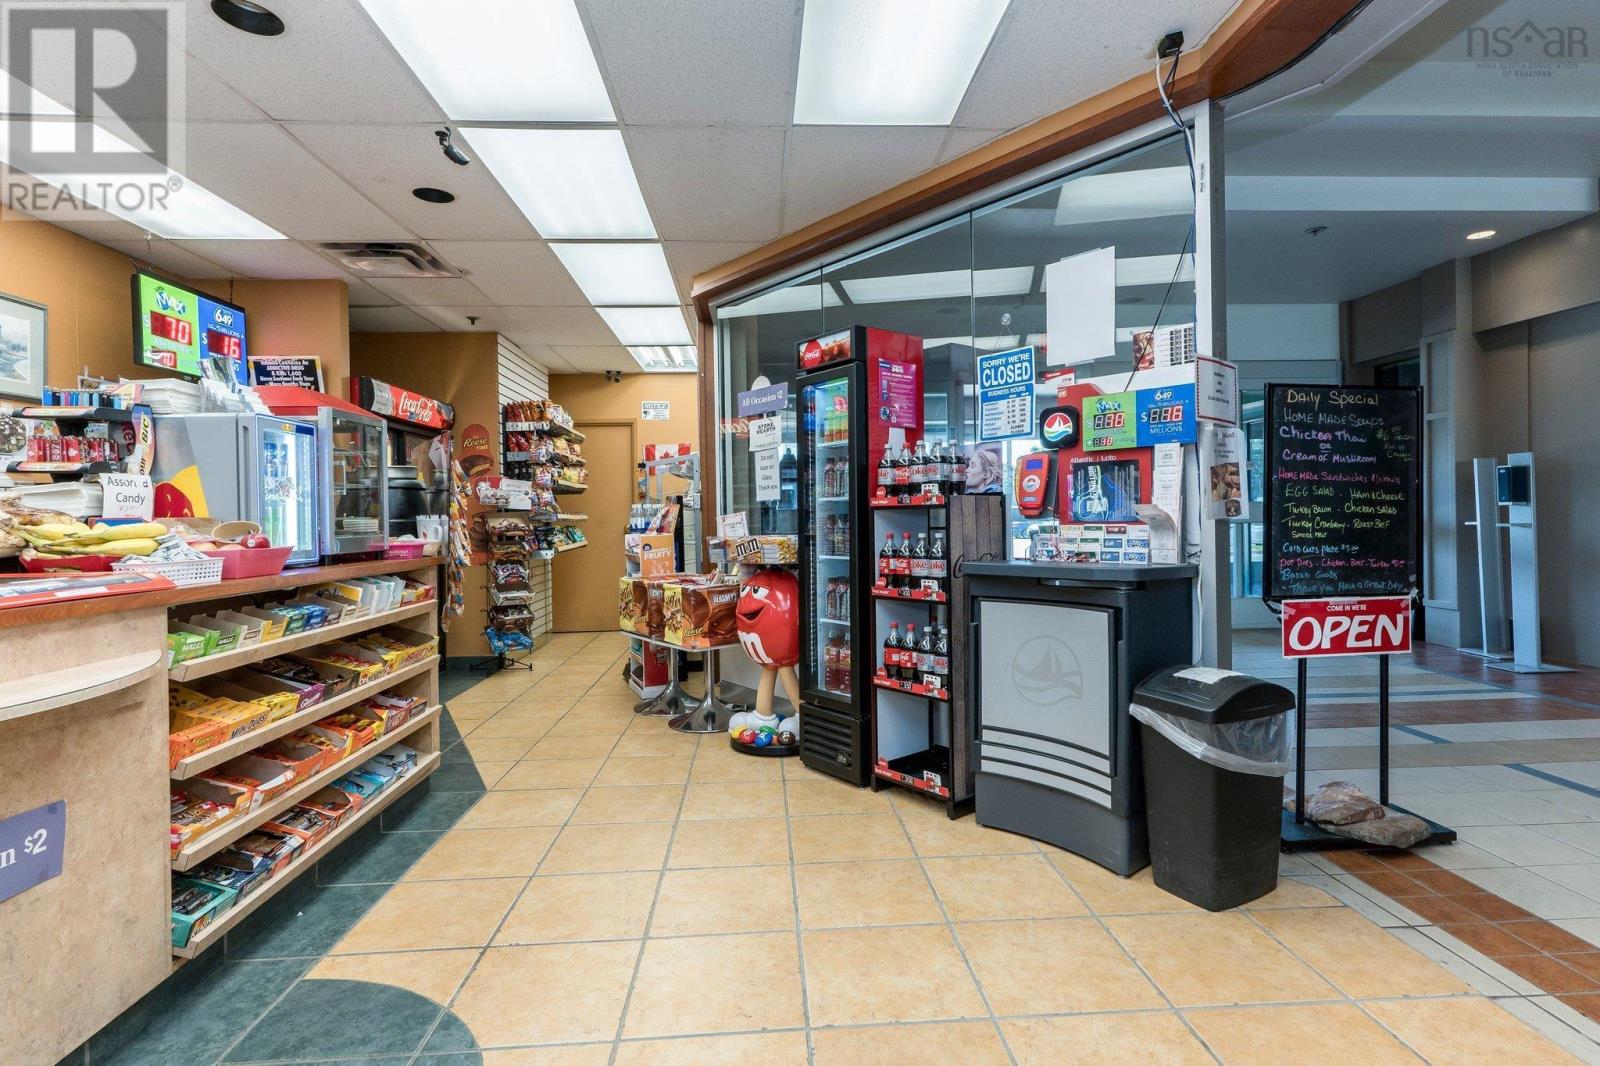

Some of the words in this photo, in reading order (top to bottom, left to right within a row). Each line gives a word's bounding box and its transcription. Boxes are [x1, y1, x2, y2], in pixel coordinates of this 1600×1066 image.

[982, 357, 1006, 368] SORRY
[1008, 353, 1030, 362] WE'RE
[983, 361, 1030, 387] CLOSED
[988, 388, 1009, 397] BUSINESS
[1010, 385, 1026, 394] HOURS
[750, 394, 777, 405] Occasion
[1329, 391, 1379, 408] Special
[1284, 407, 1314, 423] HOME
[1319, 413, 1346, 425] MADE
[142, 418, 150, 444] BIC
[1150, 426, 1183, 434] MILLIONS
[1279, 425, 1332, 441] Chicken
[1070, 455, 1094, 463] Atlantic
[1283, 449, 1317, 461] Cream
[1285, 482, 1308, 497] EGG
[115, 493, 145, 506] Candy
[1344, 500, 1375, 514] Chicken
[643, 550, 671, 560] FRUITY
[1288, 613, 1404, 651] OPEN
[182, 642, 204, 652] HALLS
[217, 636, 235, 645] HALLS
[24, 828, 48, 856] $2
